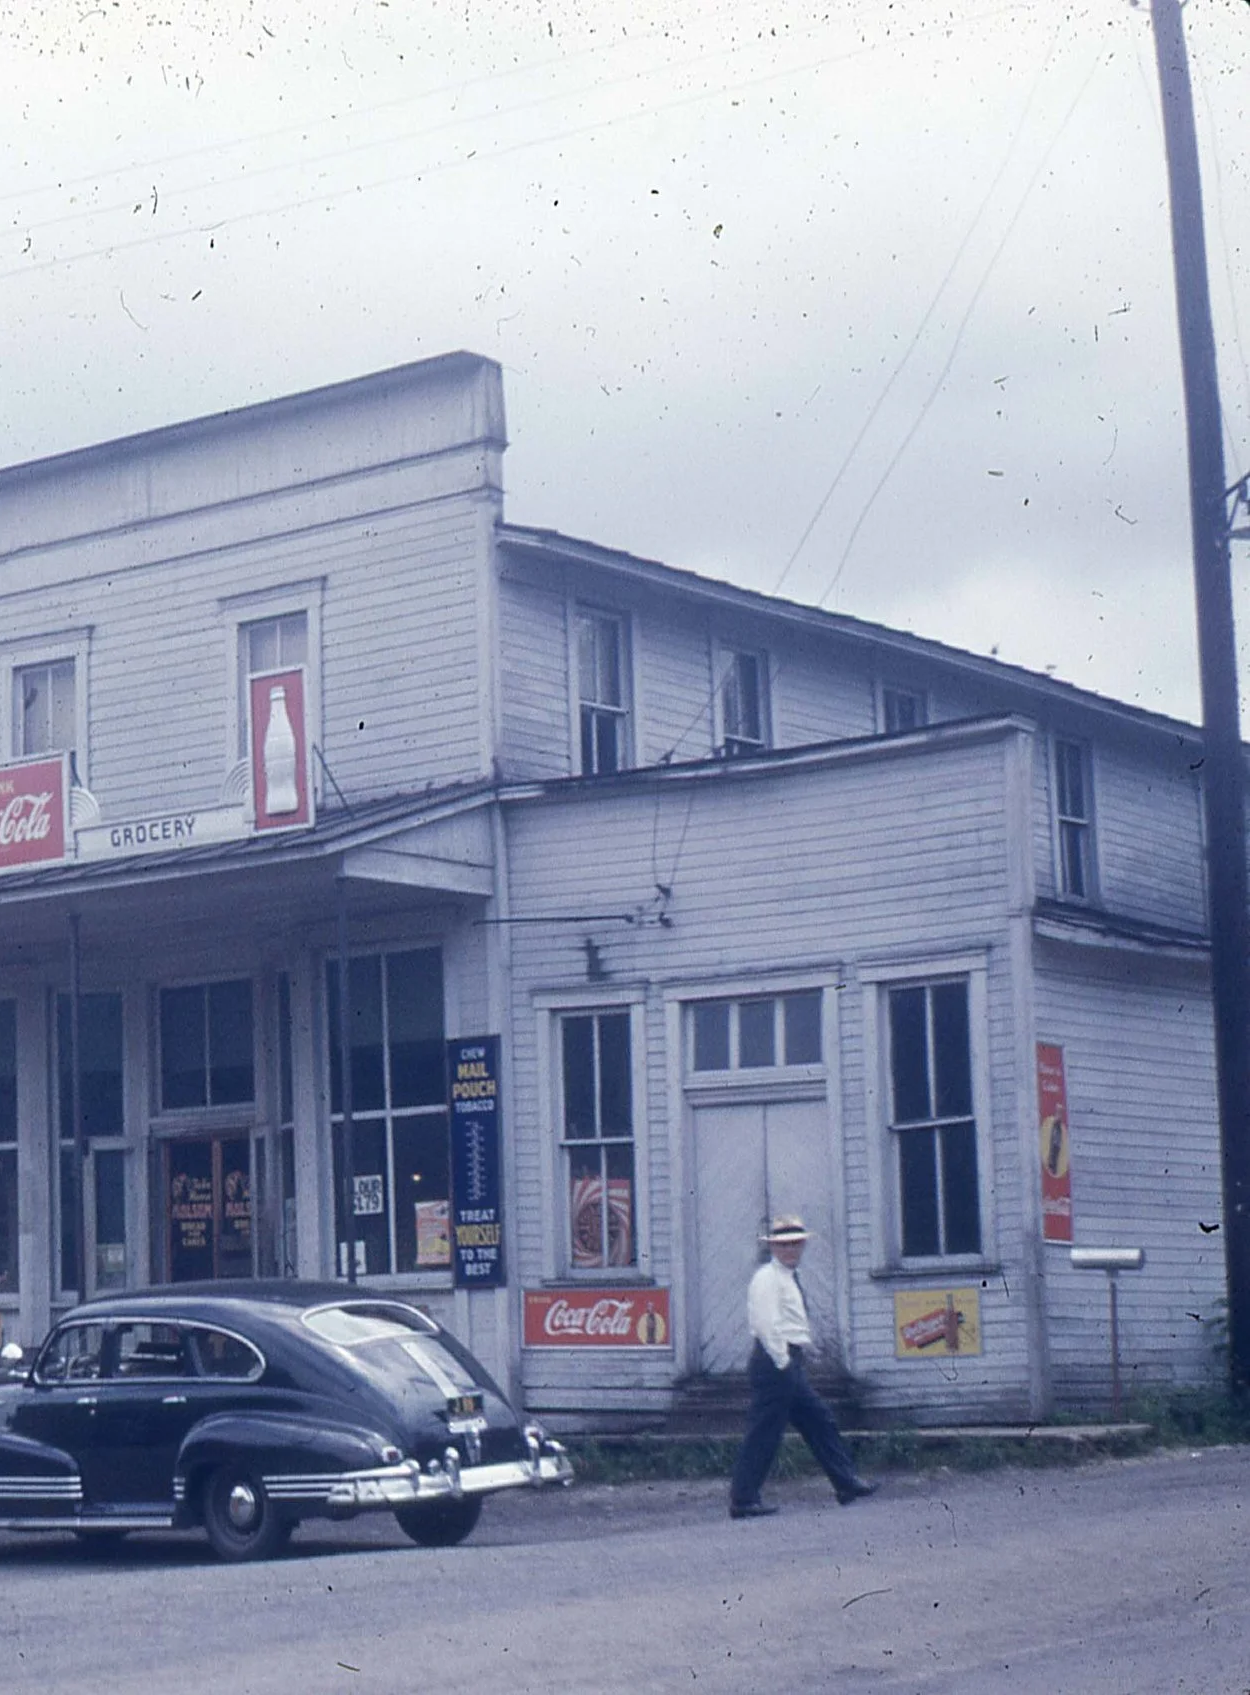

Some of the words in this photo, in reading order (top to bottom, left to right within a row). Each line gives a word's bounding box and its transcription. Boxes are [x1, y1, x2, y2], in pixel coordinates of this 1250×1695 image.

[111, 816, 195, 847] GROCERY
[457, 1062, 489, 1080] MAIL
[453, 1080, 496, 1099] POUCH
[460, 1209, 495, 1222] TREAT
[454, 1224, 500, 1247] YOURSELF
[460, 1248, 474, 1261] TO
[476, 1247, 497, 1260] THE
[465, 1262, 491, 1276] BEST
[545, 1297, 634, 1336] Coca-Cola
